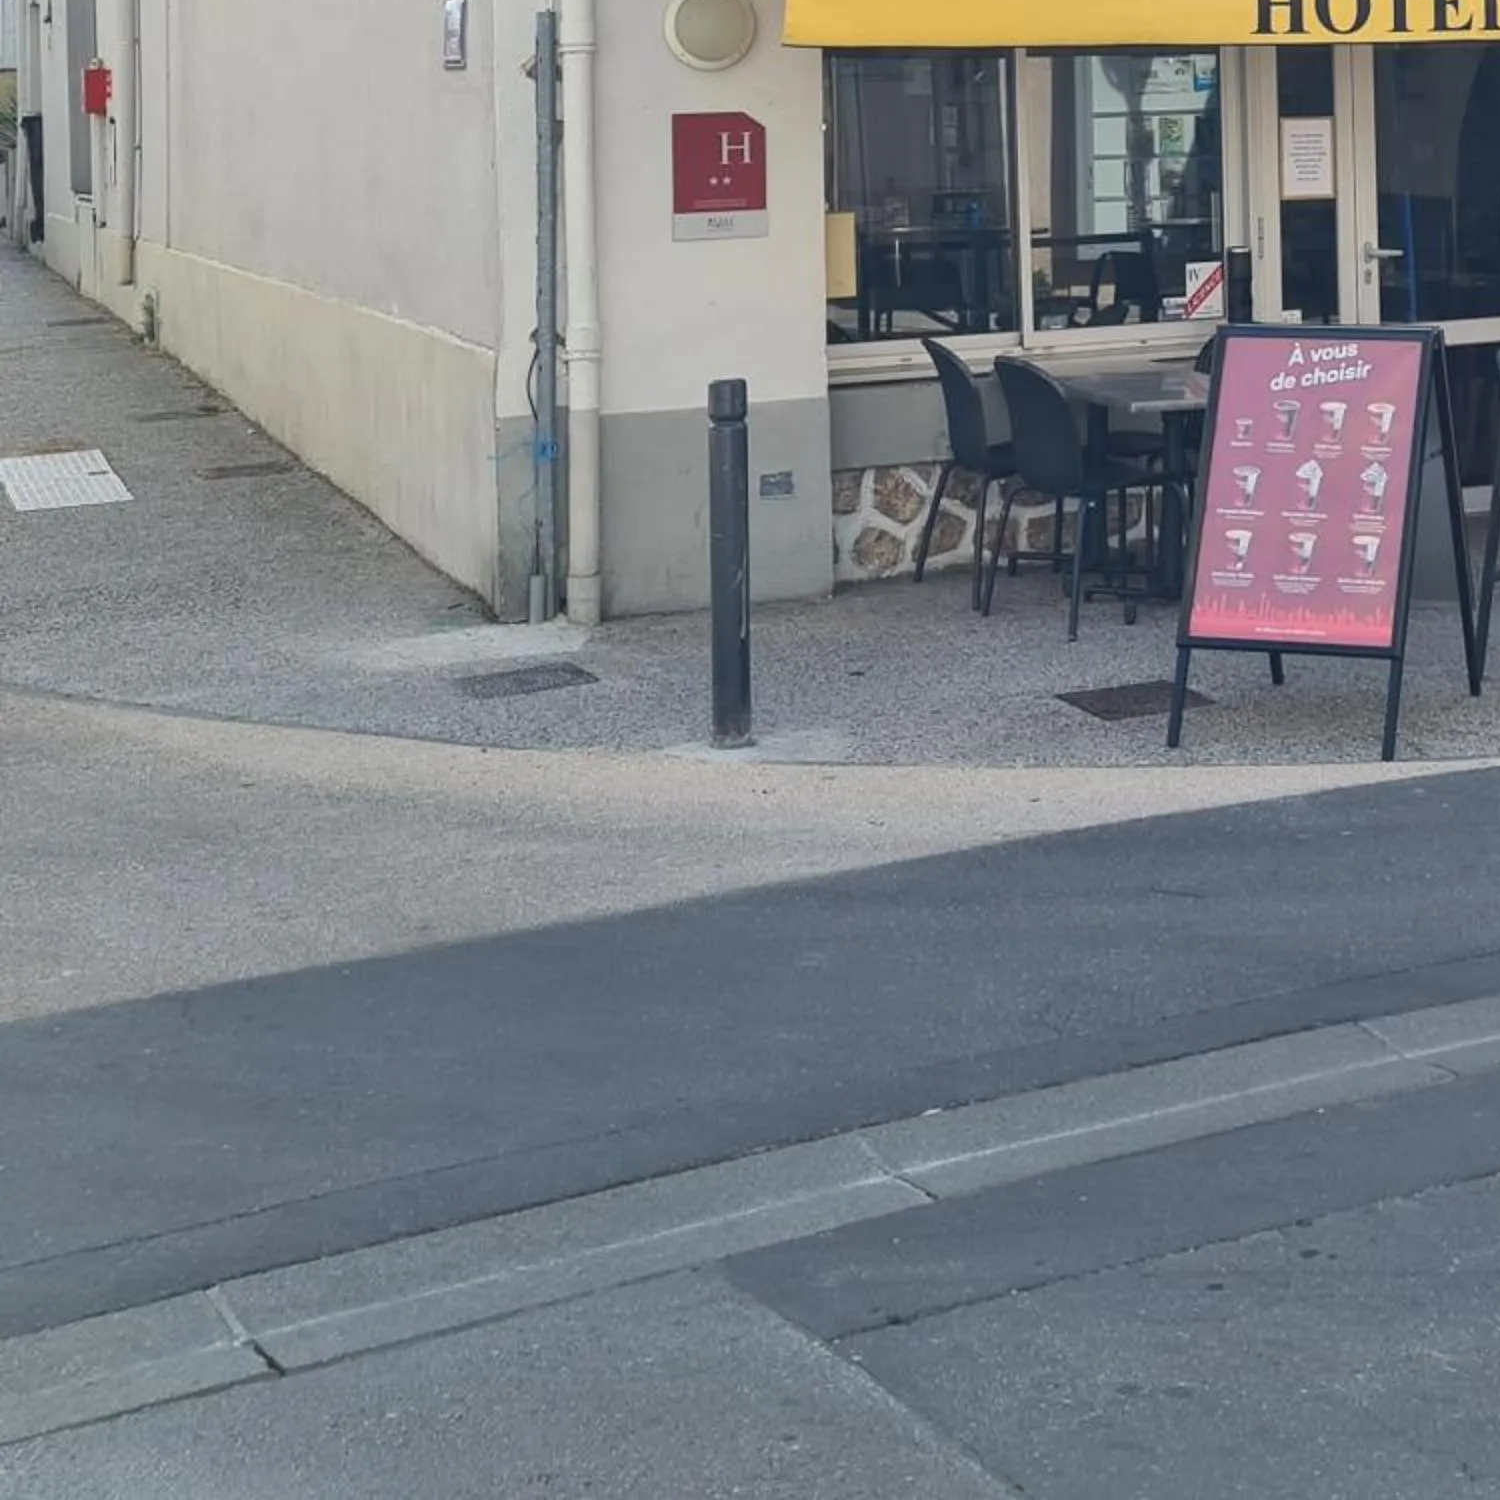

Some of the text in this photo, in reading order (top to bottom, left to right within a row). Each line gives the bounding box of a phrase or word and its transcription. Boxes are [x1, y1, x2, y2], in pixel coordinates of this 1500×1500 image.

[717, 130, 753, 166] H
[1288, 341, 1359, 367] À vous
[1269, 360, 1373, 392] de choisir
